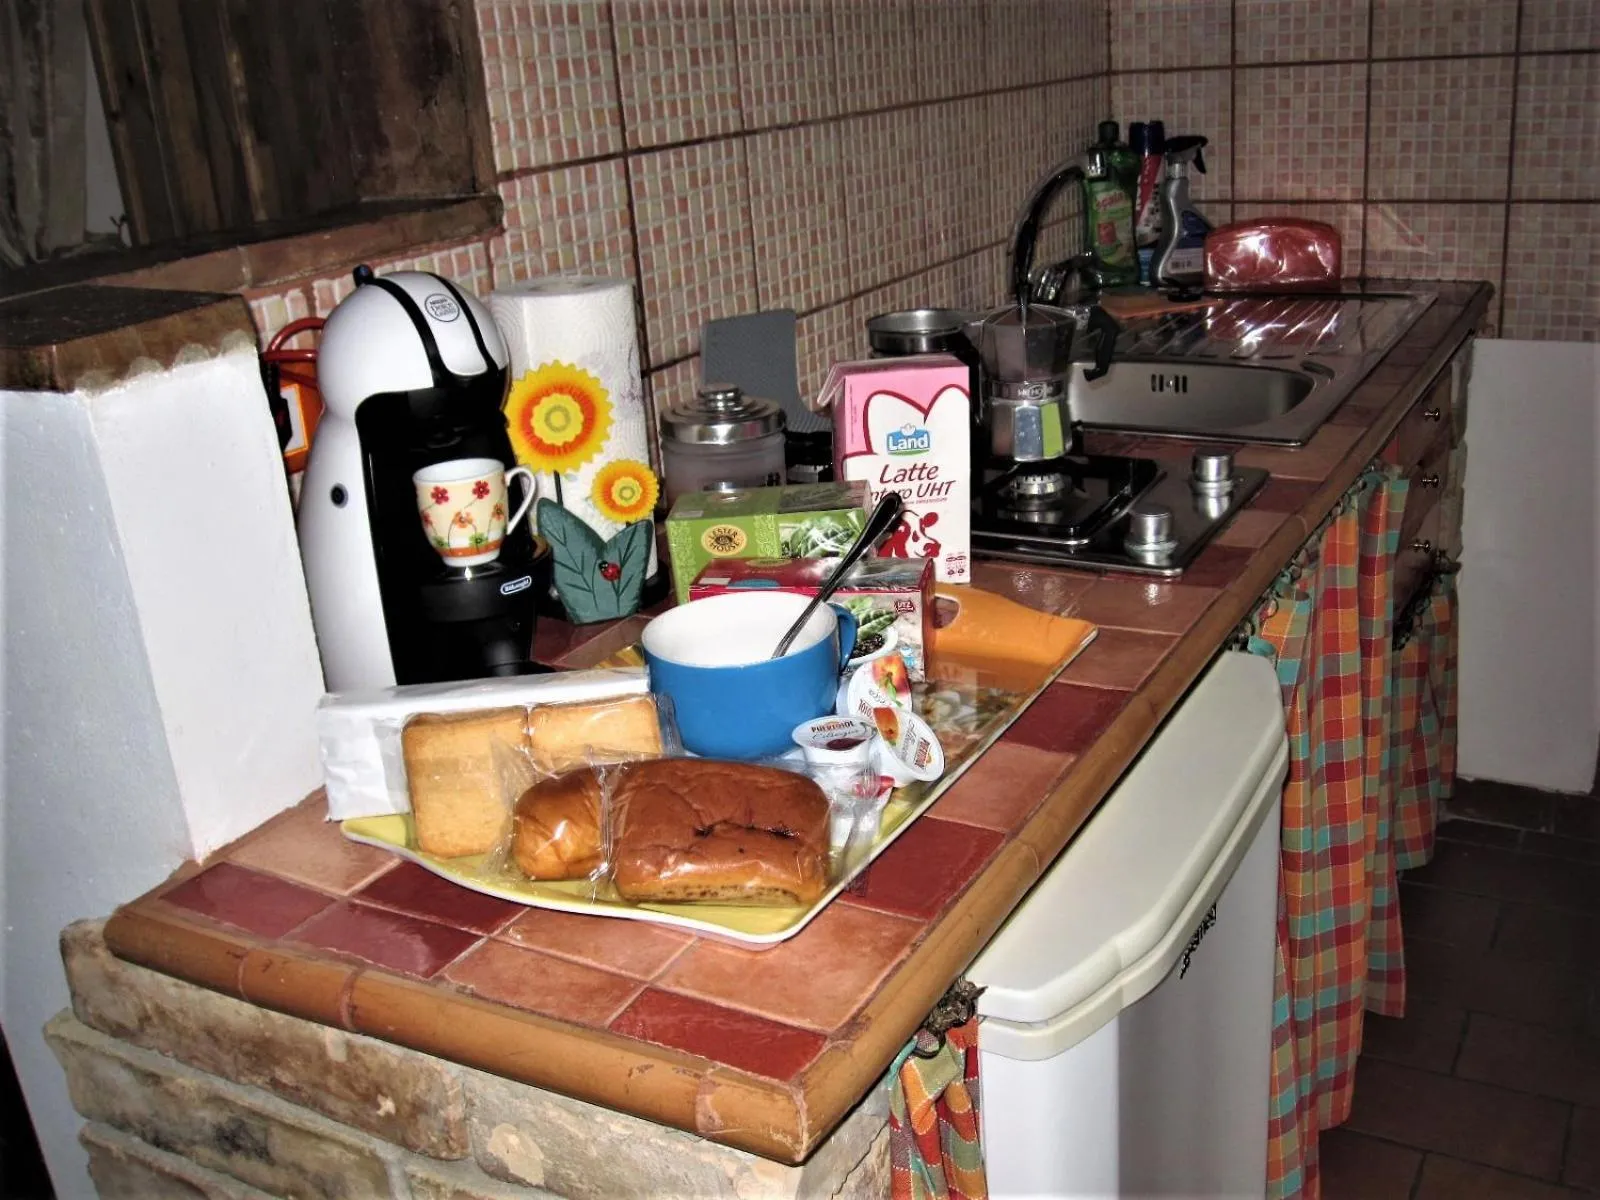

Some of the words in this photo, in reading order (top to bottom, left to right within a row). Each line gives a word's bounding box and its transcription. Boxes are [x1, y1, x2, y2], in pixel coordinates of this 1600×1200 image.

[889, 432, 929, 450] Land
[880, 462, 939, 484] Latte
[870, 487, 912, 501] ntro
[917, 479, 956, 498] UHT
[708, 528, 738, 540] LESTER
[709, 540, 740, 552] HOUSE
